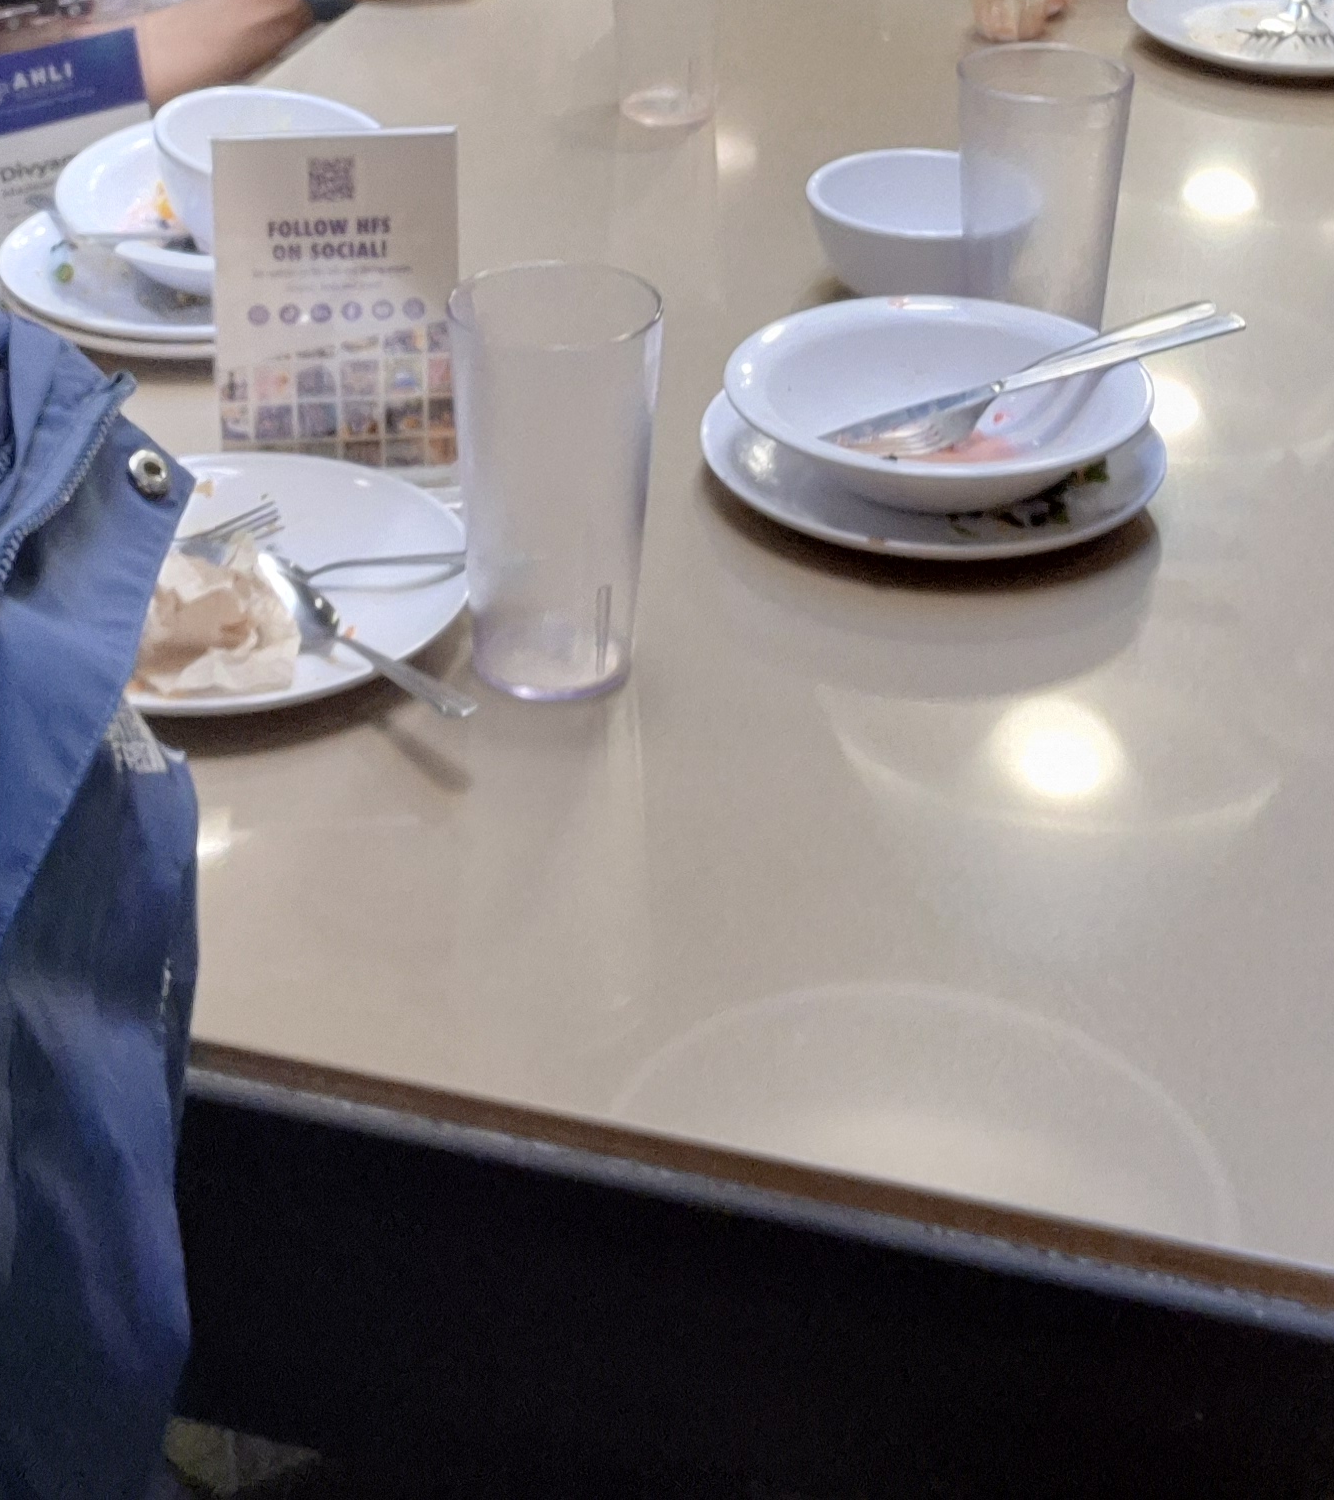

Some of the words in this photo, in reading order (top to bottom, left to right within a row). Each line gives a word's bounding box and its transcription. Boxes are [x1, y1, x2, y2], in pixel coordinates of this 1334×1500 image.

[12, 62, 73, 90] AHLI
[268, 218, 348, 238] FOLLOW
[272, 243, 301, 262] ON
[310, 240, 387, 261] SOCIAL!
